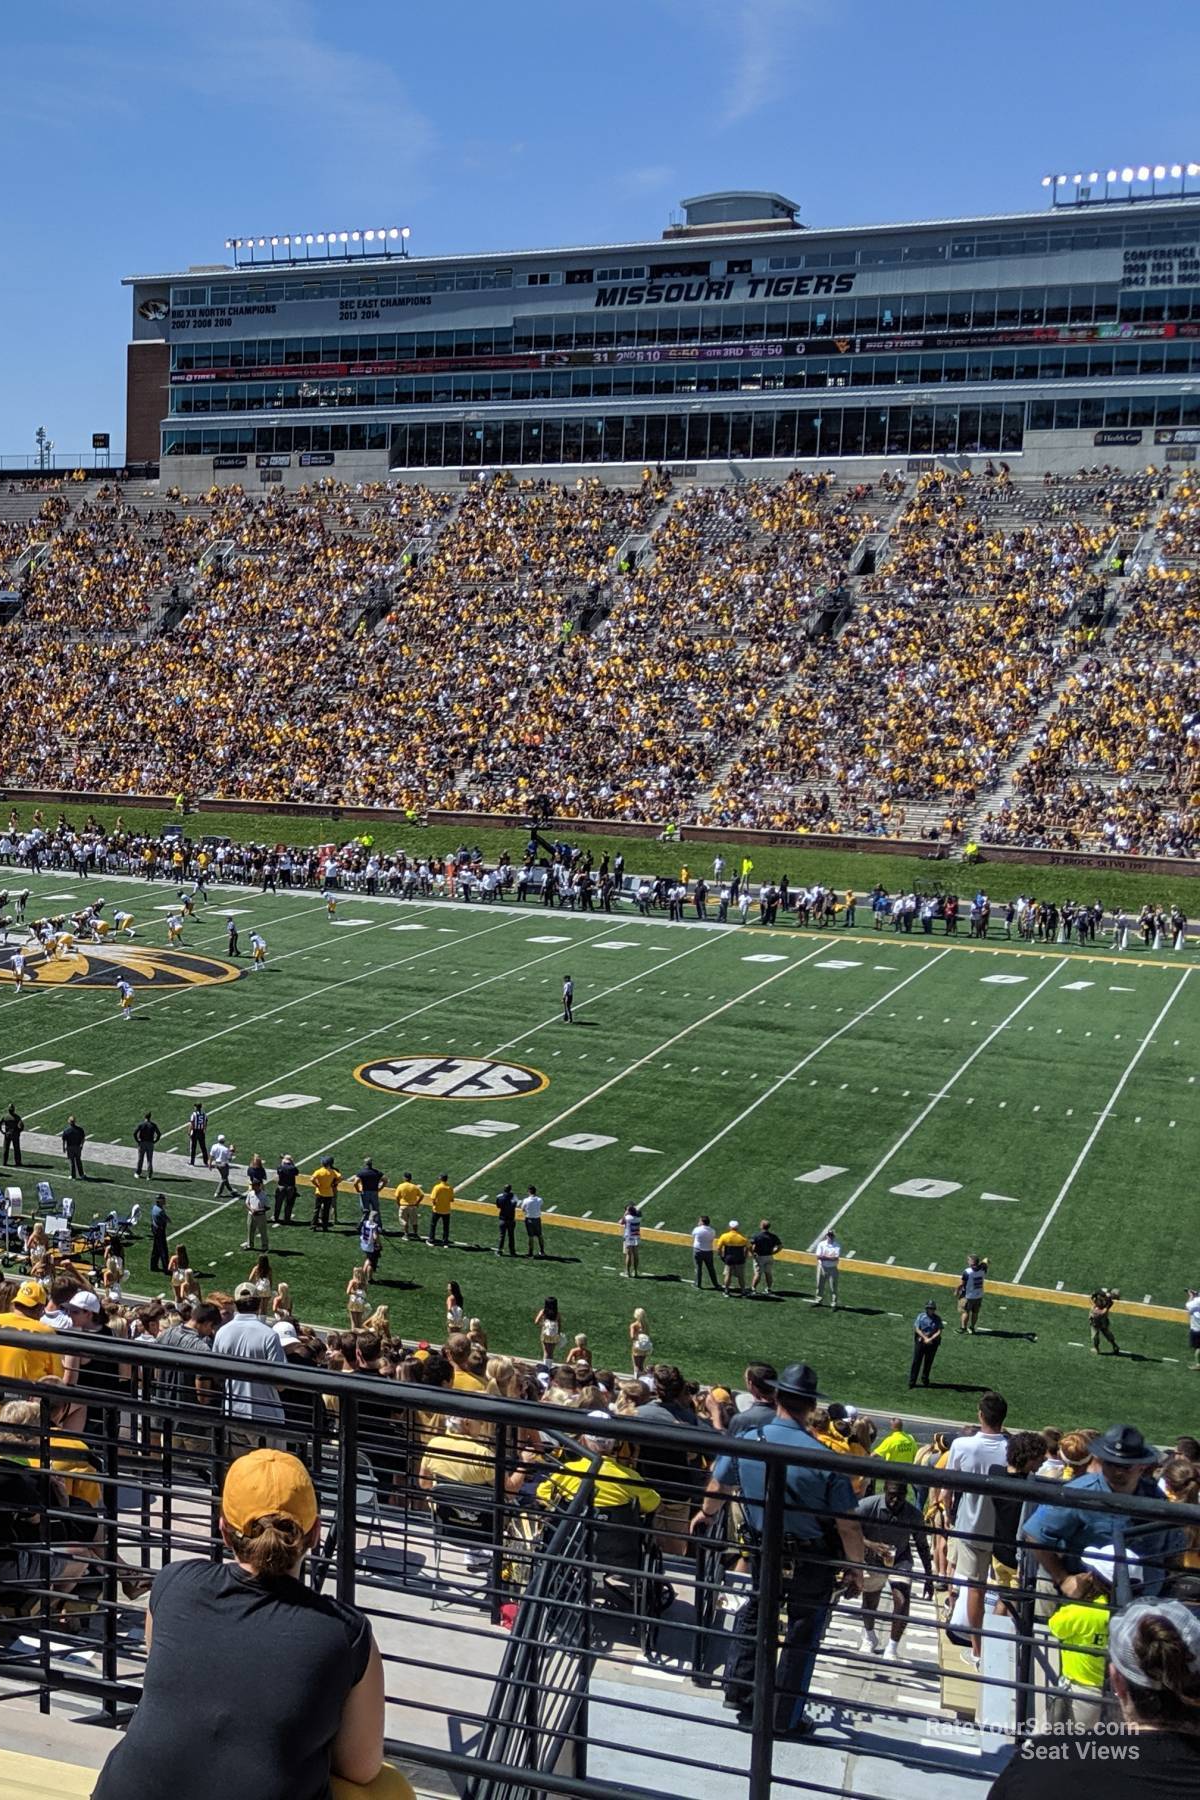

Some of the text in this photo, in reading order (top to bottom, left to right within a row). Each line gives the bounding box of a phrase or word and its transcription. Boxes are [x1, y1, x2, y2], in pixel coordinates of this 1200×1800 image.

[595, 273, 857, 307] MISSOURI TIGERS
[339, 296, 432, 310] SEC EAST CHAMPIONS
[171, 310, 185, 319] BIG
[198, 307, 226, 317] NORTH
[228, 305, 277, 316] CHAMPIONS
[339, 310, 381, 320] 2013 2014
[171, 321, 190, 330] 2007
[214, 318, 232, 328] 2010
[723, 348, 744, 357] 3RD
